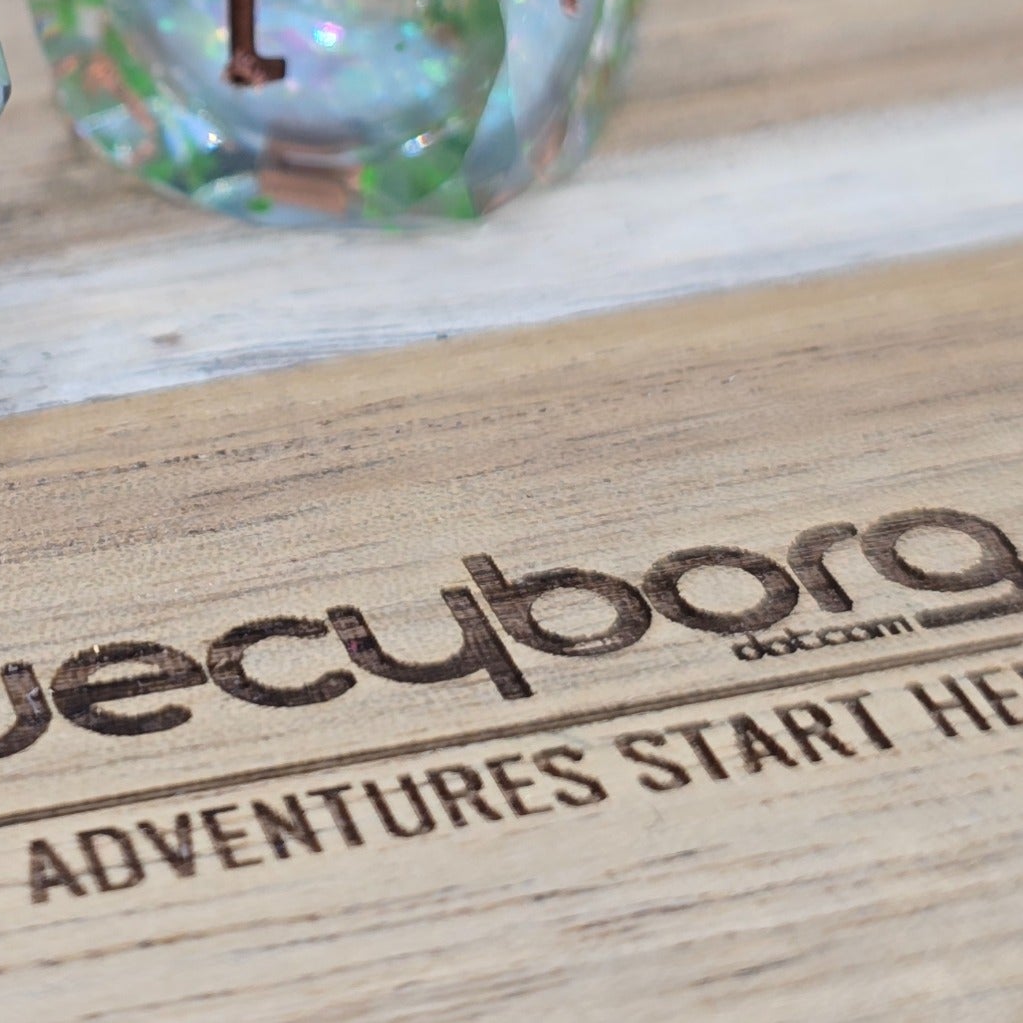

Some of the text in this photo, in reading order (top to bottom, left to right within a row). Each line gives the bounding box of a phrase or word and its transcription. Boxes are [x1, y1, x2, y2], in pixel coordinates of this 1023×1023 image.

[731, 614, 913, 661] dotcom
[27, 746, 608, 904] ADVENTURES
[615, 689, 894, 792] START
[904, 661, 1023, 738] HE
